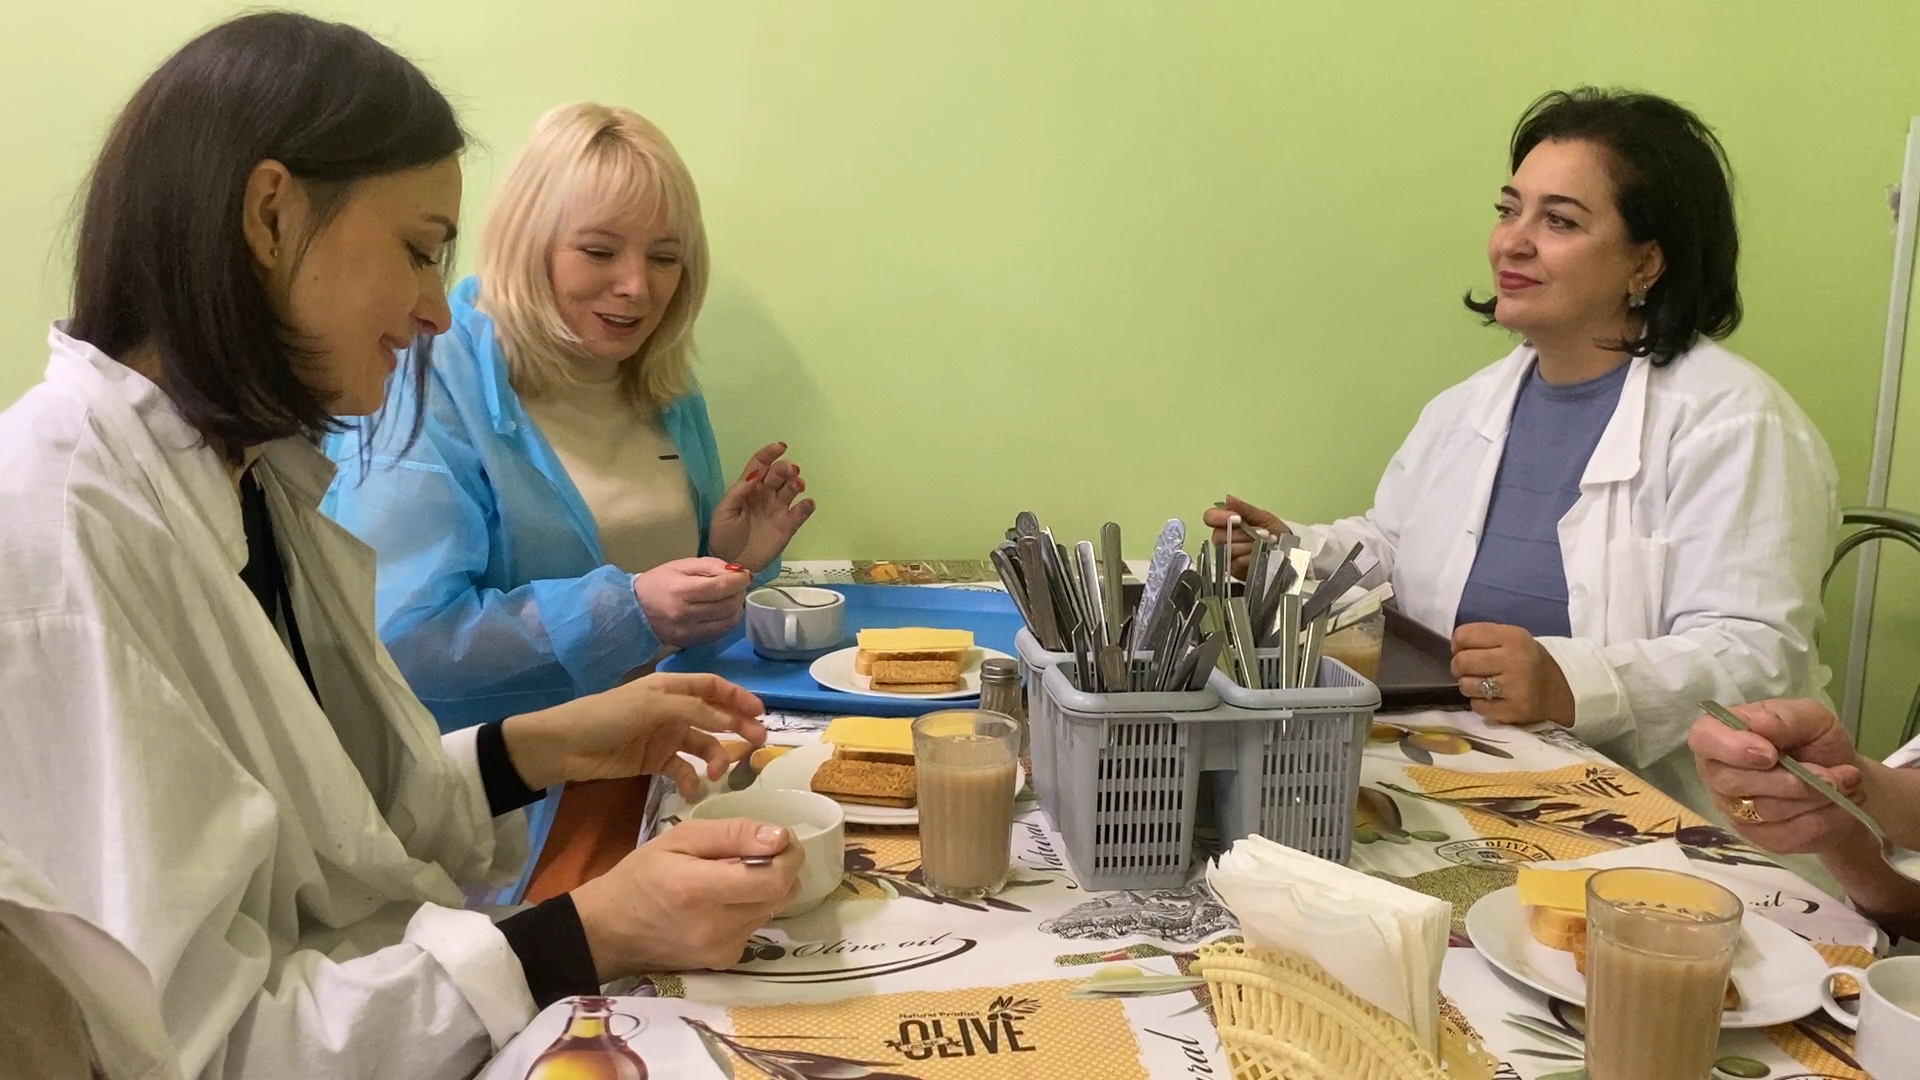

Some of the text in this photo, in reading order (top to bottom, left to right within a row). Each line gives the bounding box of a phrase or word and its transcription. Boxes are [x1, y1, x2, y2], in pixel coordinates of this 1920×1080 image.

[1012, 820, 1078, 889] Natural
[1485, 840, 1529, 853] OLIVE
[792, 932, 952, 958] Olive oil
[899, 1016, 1036, 1060] OLIVE
[1143, 1028, 1215, 1080] ral
